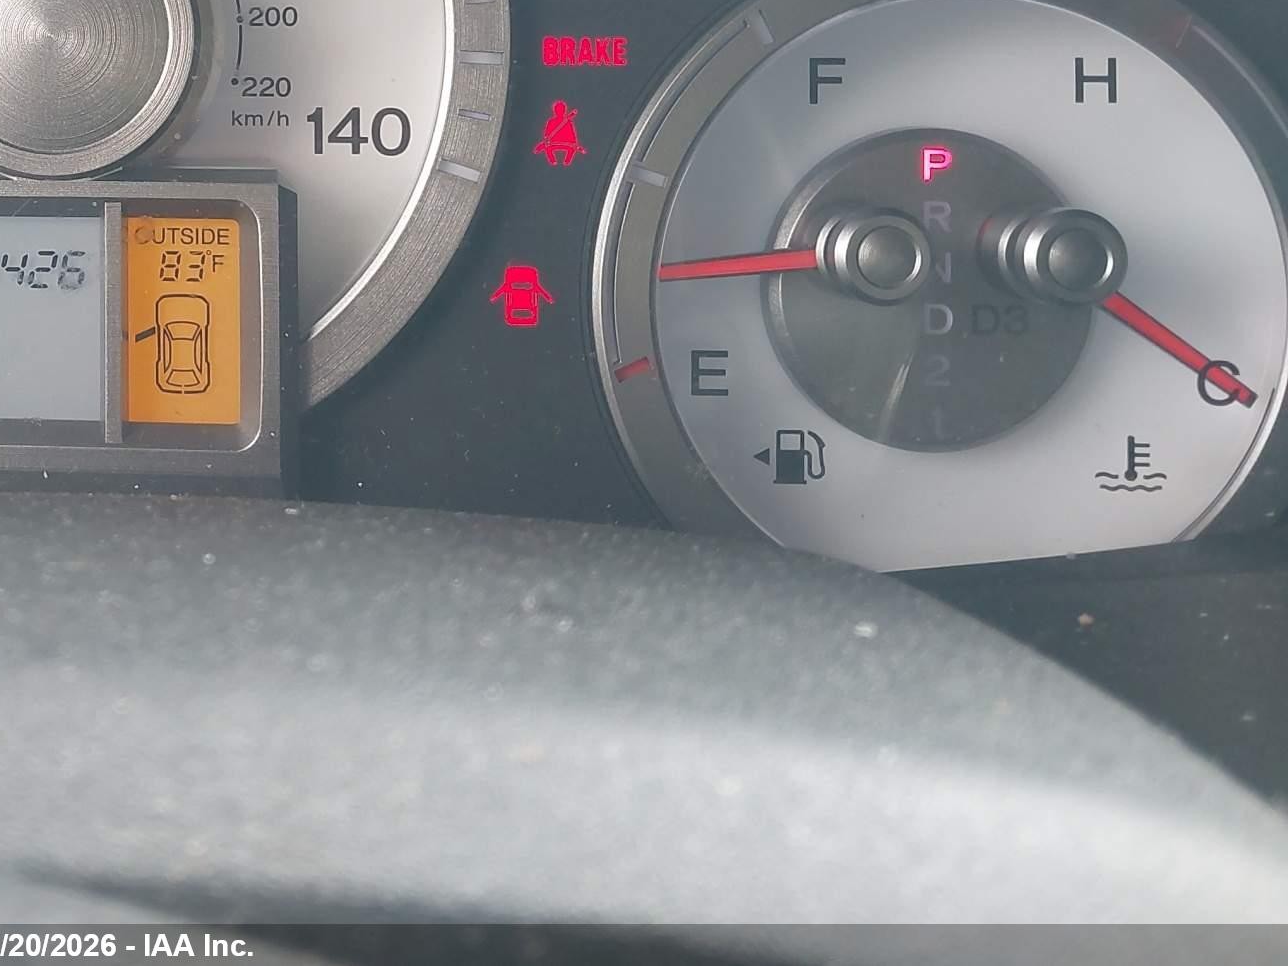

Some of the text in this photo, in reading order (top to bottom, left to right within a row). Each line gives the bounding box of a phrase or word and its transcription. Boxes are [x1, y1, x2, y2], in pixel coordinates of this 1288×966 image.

[247, 5, 298, 27] 200
[542, 36, 628, 67] BRAKE
[242, 76, 292, 98] 220
[808, 57, 846, 104] F
[1074, 57, 1117, 103] H
[230, 108, 290, 128] km/h
[306, 107, 412, 155] 140
[921, 147, 953, 183] P
[923, 201, 951, 233] R
[134, 227, 230, 246] OUTSIDE
[925, 303, 954, 335] D
[691, 351, 728, 396] E
[925, 355, 951, 385] 2
[1196, 361, 1240, 406] C
